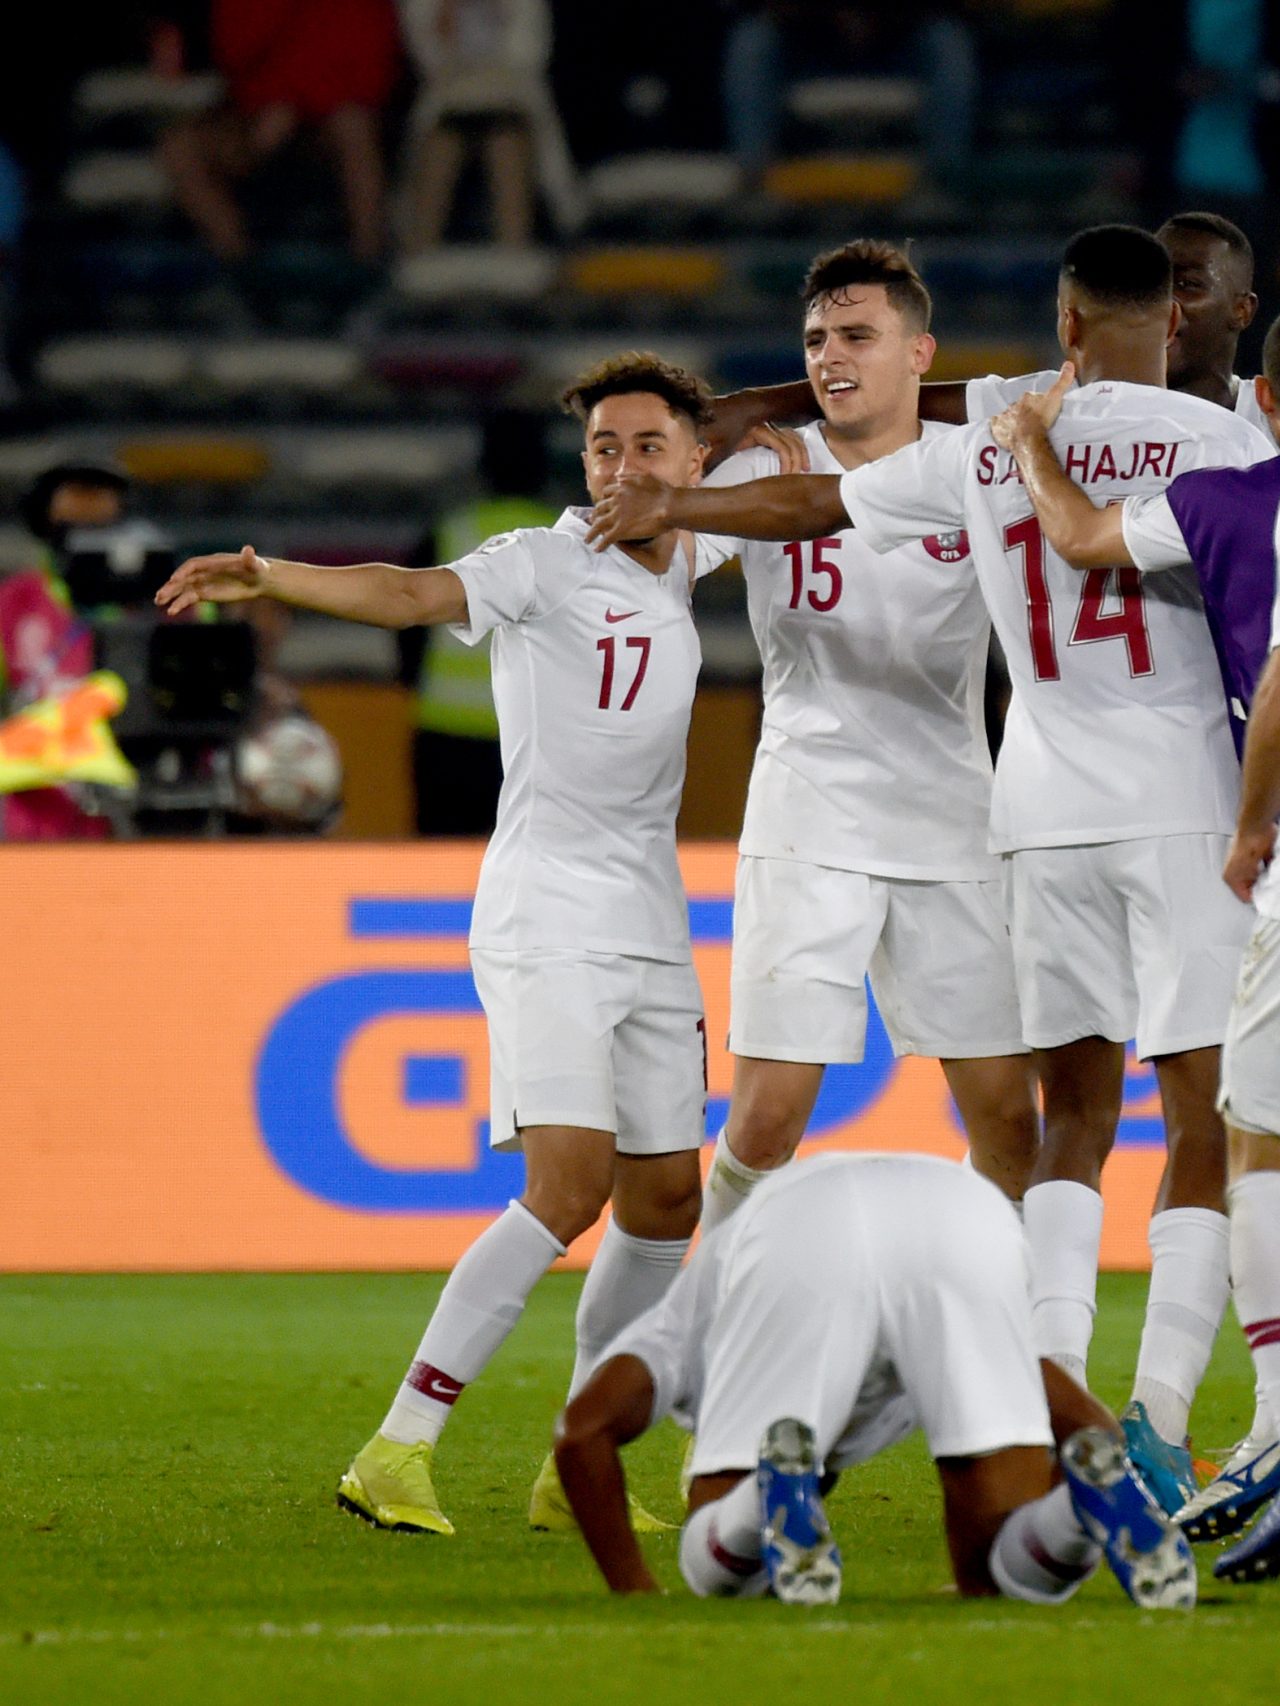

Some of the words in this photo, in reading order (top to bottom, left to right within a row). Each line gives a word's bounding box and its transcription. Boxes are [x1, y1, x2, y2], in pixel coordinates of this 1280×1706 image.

[783, 537, 843, 613] 15
[1003, 498, 1156, 683] 14
[596, 636, 652, 712] 17
